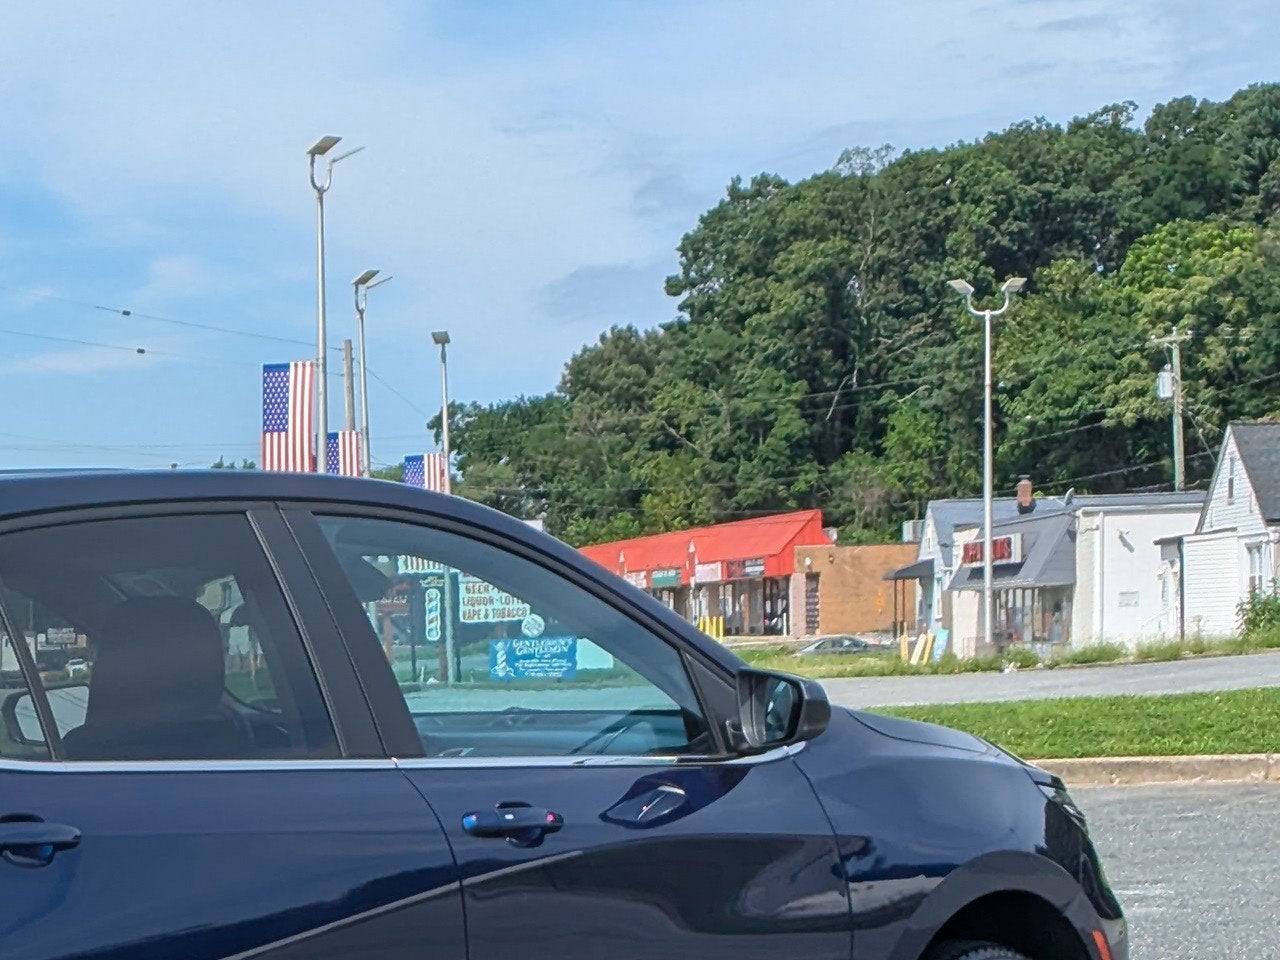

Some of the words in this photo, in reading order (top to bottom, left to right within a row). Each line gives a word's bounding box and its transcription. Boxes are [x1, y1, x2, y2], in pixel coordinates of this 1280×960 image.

[465, 584, 490, 594] BEER
[462, 596, 495, 607] LIQUOR
[491, 606, 528, 619] TOBACCO
